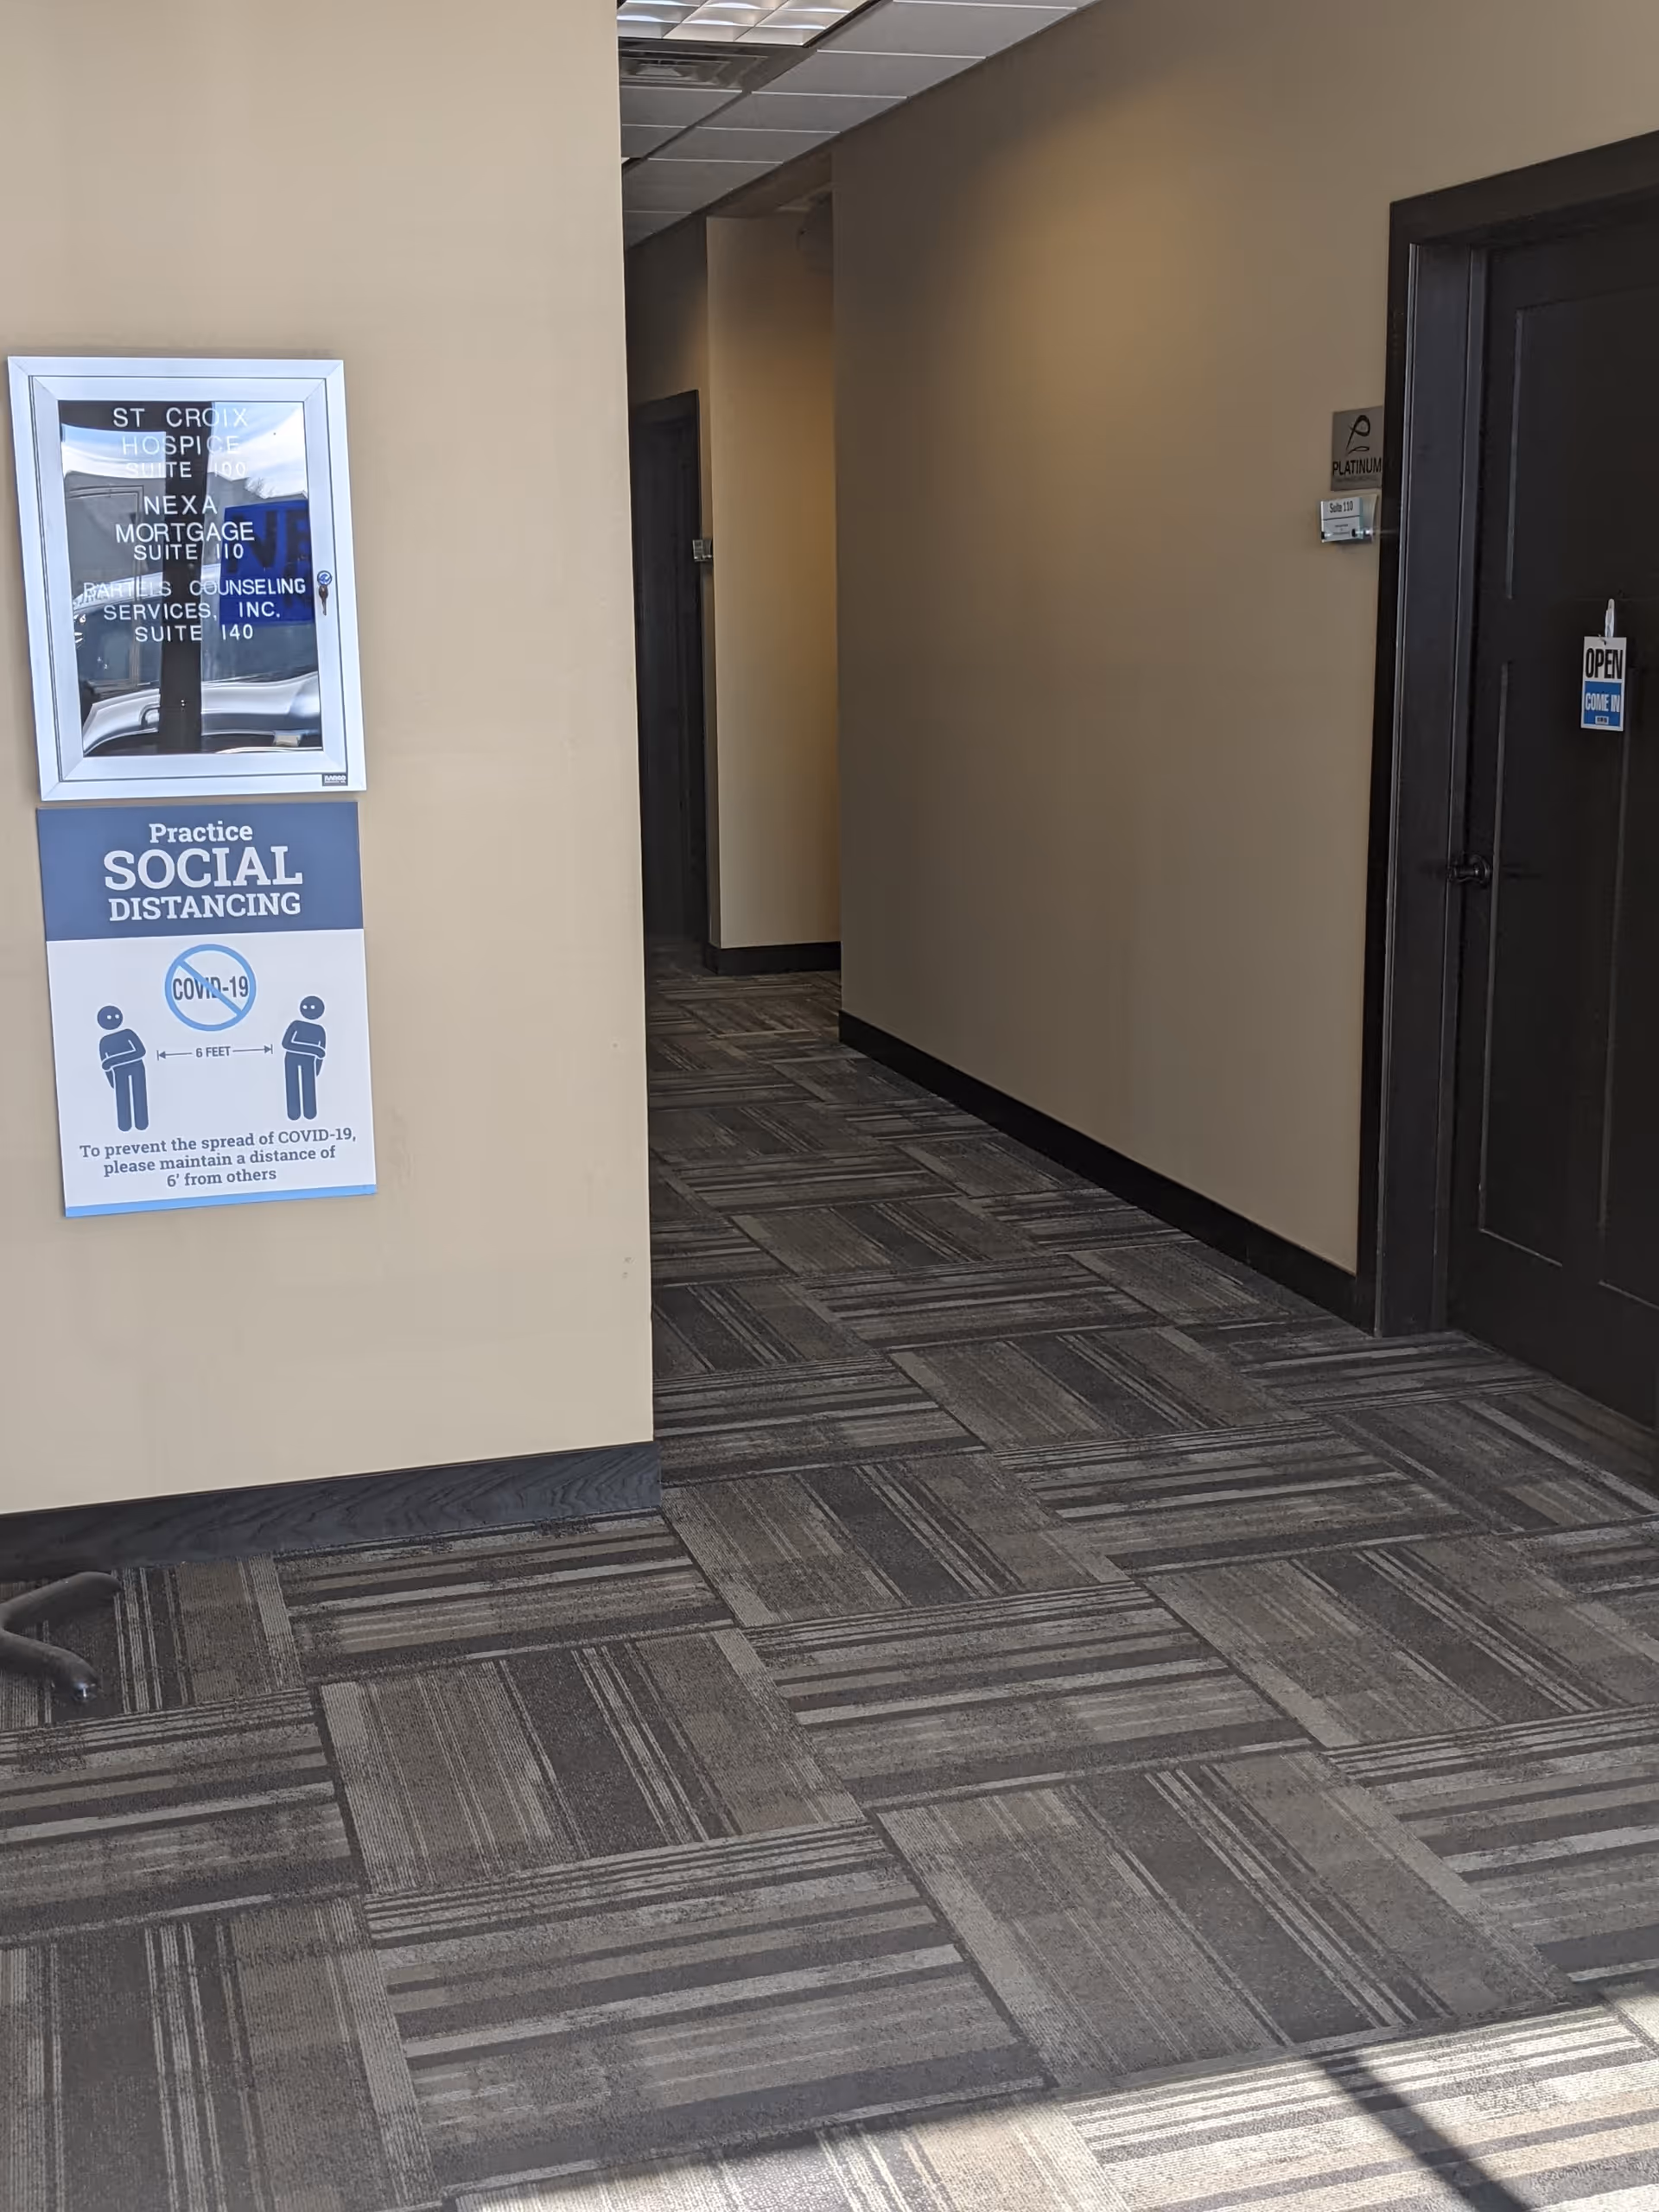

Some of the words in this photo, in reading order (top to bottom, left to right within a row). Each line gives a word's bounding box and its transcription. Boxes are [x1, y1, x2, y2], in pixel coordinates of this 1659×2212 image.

[113, 408, 144, 427] ST
[166, 407, 249, 428] CROIX
[122, 435, 241, 455] HOSPICE
[125, 461, 192, 478] SUITE
[214, 461, 245, 477] 100
[1332, 457, 1382, 476] PLATINUM
[143, 495, 218, 515] NEXA
[1329, 502, 1342, 513] Suite
[1343, 500, 1354, 512] 110
[115, 521, 255, 543] MORTGAGE
[134, 543, 197, 561] SUITE
[216, 543, 245, 560] 110
[189, 578, 306, 596] COUNSELING
[104, 603, 218, 621] SERVICES,
[238, 601, 281, 618] INC.
[135, 625, 202, 643] SUITE
[221, 624, 253, 640] 140
[1585, 648, 1623, 679] OPEN
[1585, 693, 1609, 712] COME
[1611, 694, 1620, 713] IN
[149, 820, 254, 843] Practice
[103, 845, 303, 891] SOCIAL
[108, 892, 302, 922] DISTANCING
[173, 976, 249, 1001] COVID-19
[195, 1047, 203, 1058] 6
[206, 1046, 231, 1058] FEET
[79, 1145, 100, 1158] To
[105, 1140, 167, 1160] prevent
[171, 1137, 197, 1152] the
[201, 1134, 255, 1153] spread
[258, 1132, 275, 1145] of
[278, 1128, 357, 1144] COVID-19,
[104, 1160, 156, 1177] please
[159, 1153, 233, 1171] maintain
[237, 1154, 246, 1166] a
[250, 1147, 316, 1164] distance
[321, 1145, 336, 1160] of
[184, 1172, 223, 1186] from
[226, 1168, 277, 1183] others
